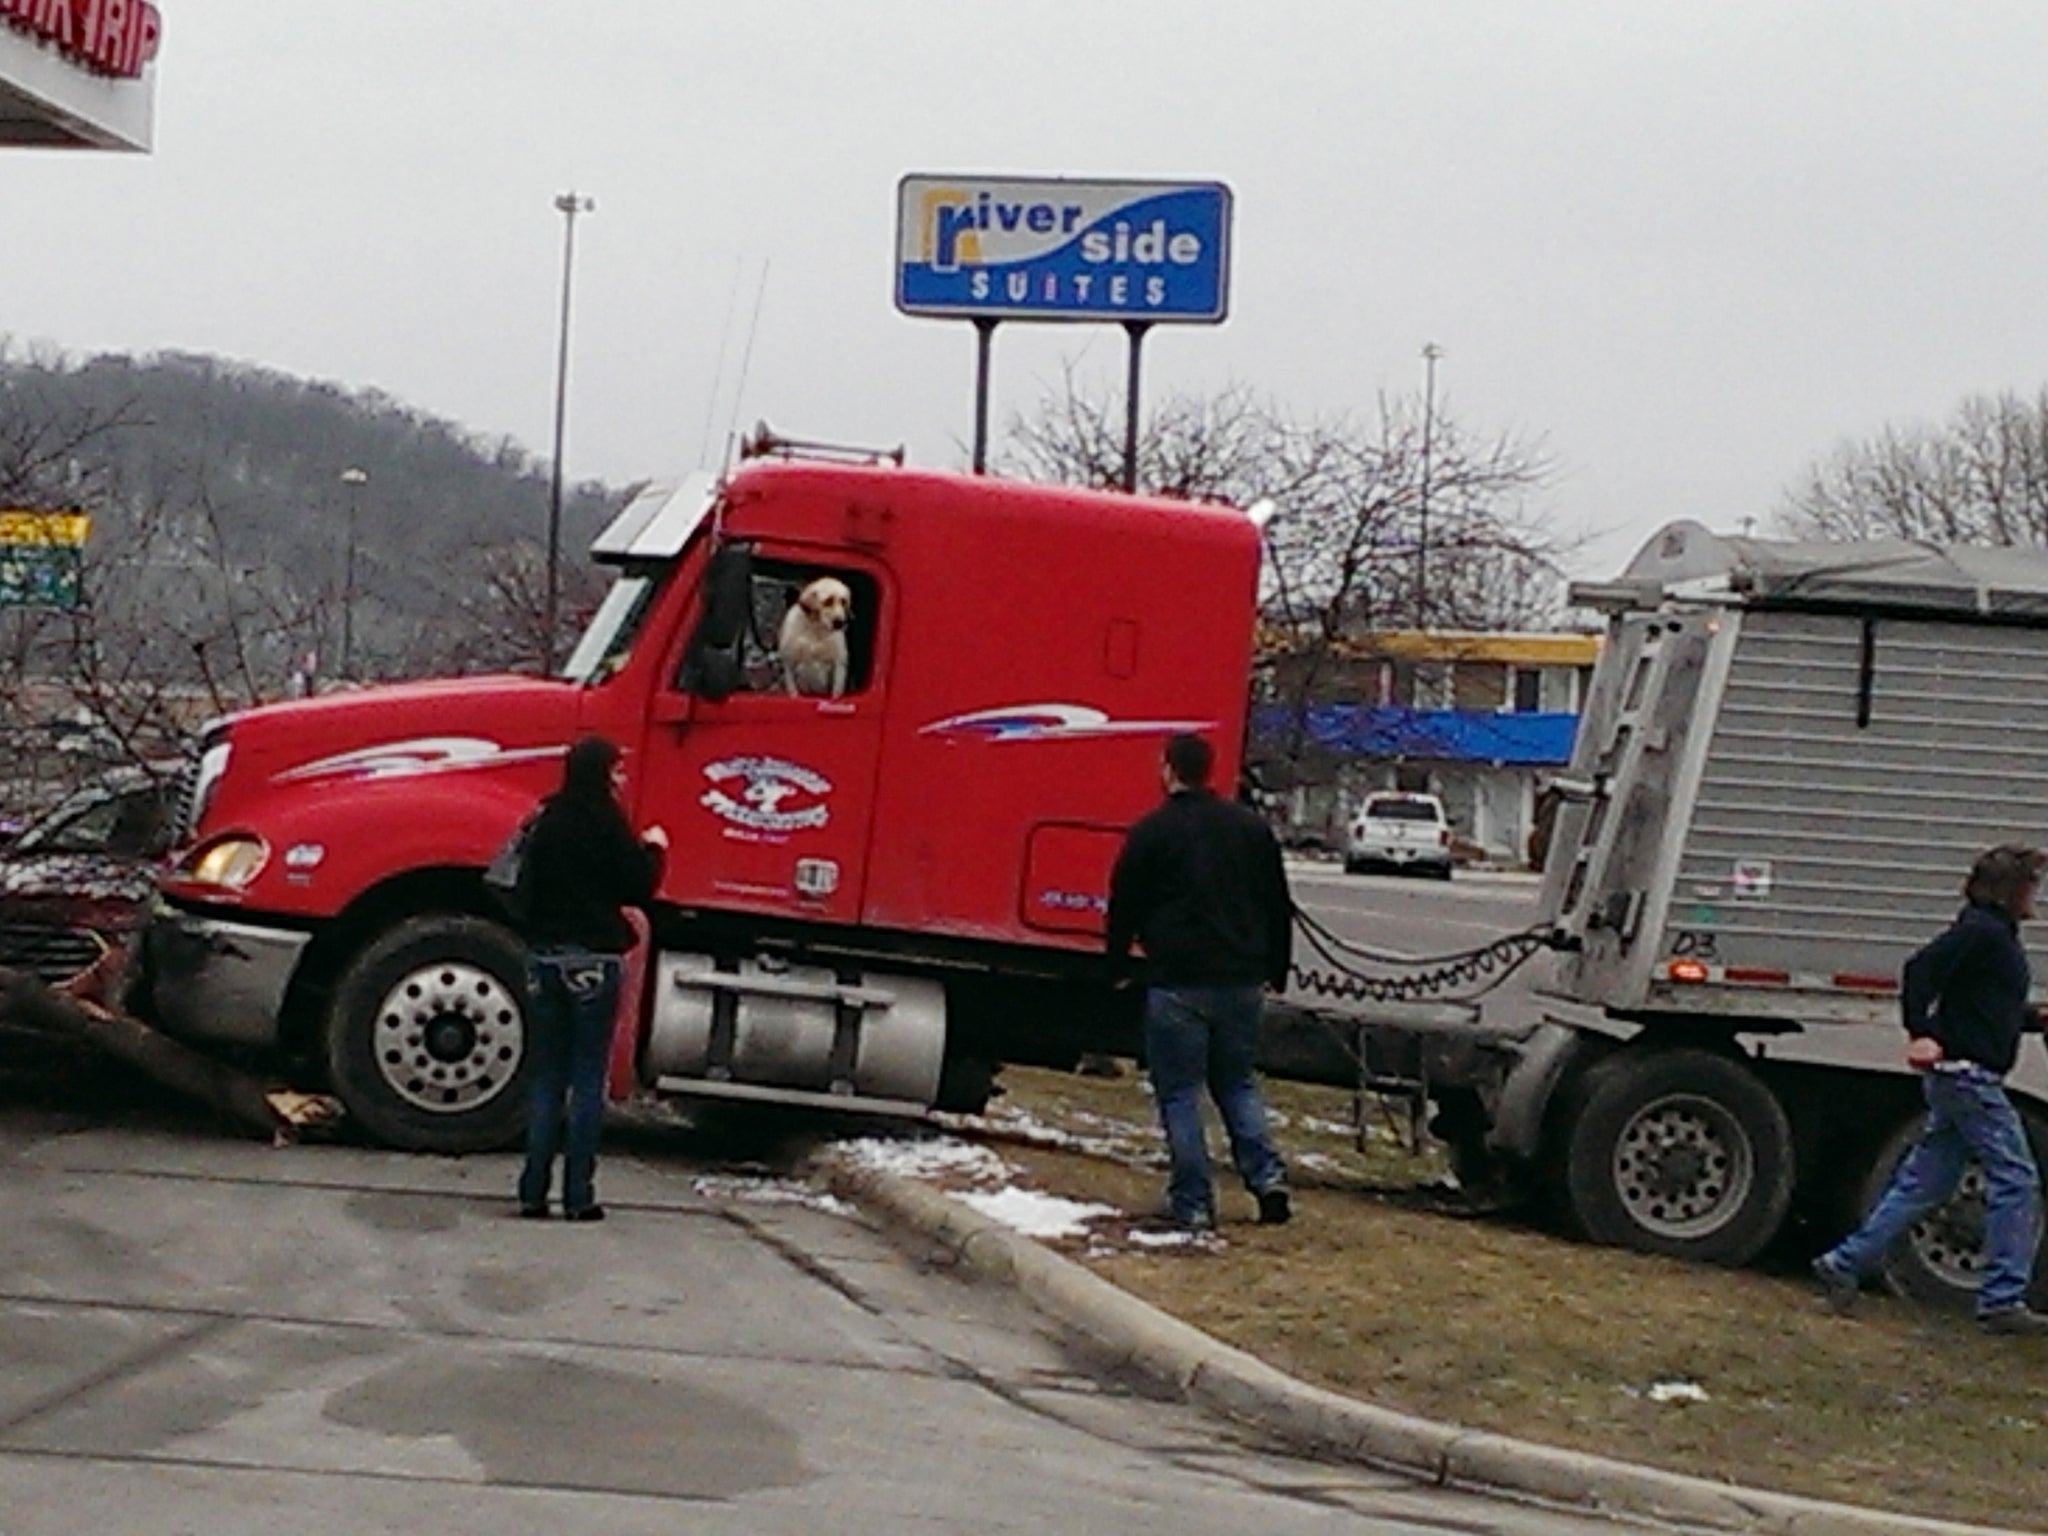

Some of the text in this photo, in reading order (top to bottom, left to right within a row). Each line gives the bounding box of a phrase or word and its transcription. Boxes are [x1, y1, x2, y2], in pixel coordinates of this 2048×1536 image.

[934, 192, 1082, 269] river
[1081, 221, 1201, 263] side
[971, 271, 1165, 305] SUITES
